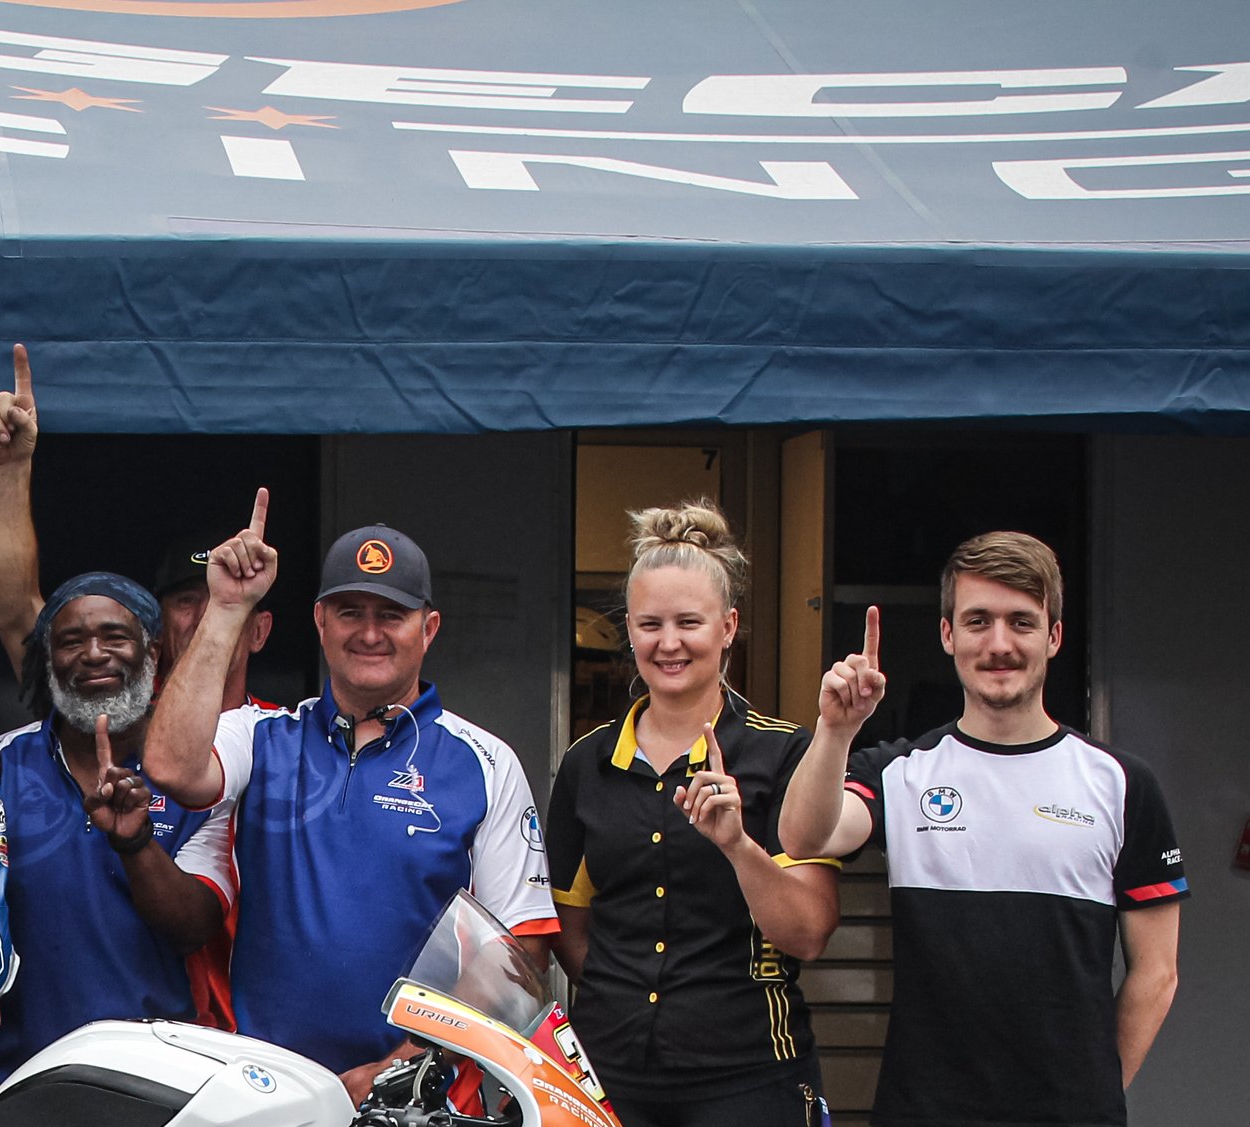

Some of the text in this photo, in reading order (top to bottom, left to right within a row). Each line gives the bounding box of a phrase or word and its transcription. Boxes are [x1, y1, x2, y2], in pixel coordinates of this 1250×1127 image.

[701, 450, 717, 470] 7
[381, 804, 423, 815] RACING
[1037, 804, 1095, 823] alpha
[406, 1004, 469, 1030] URIBE
